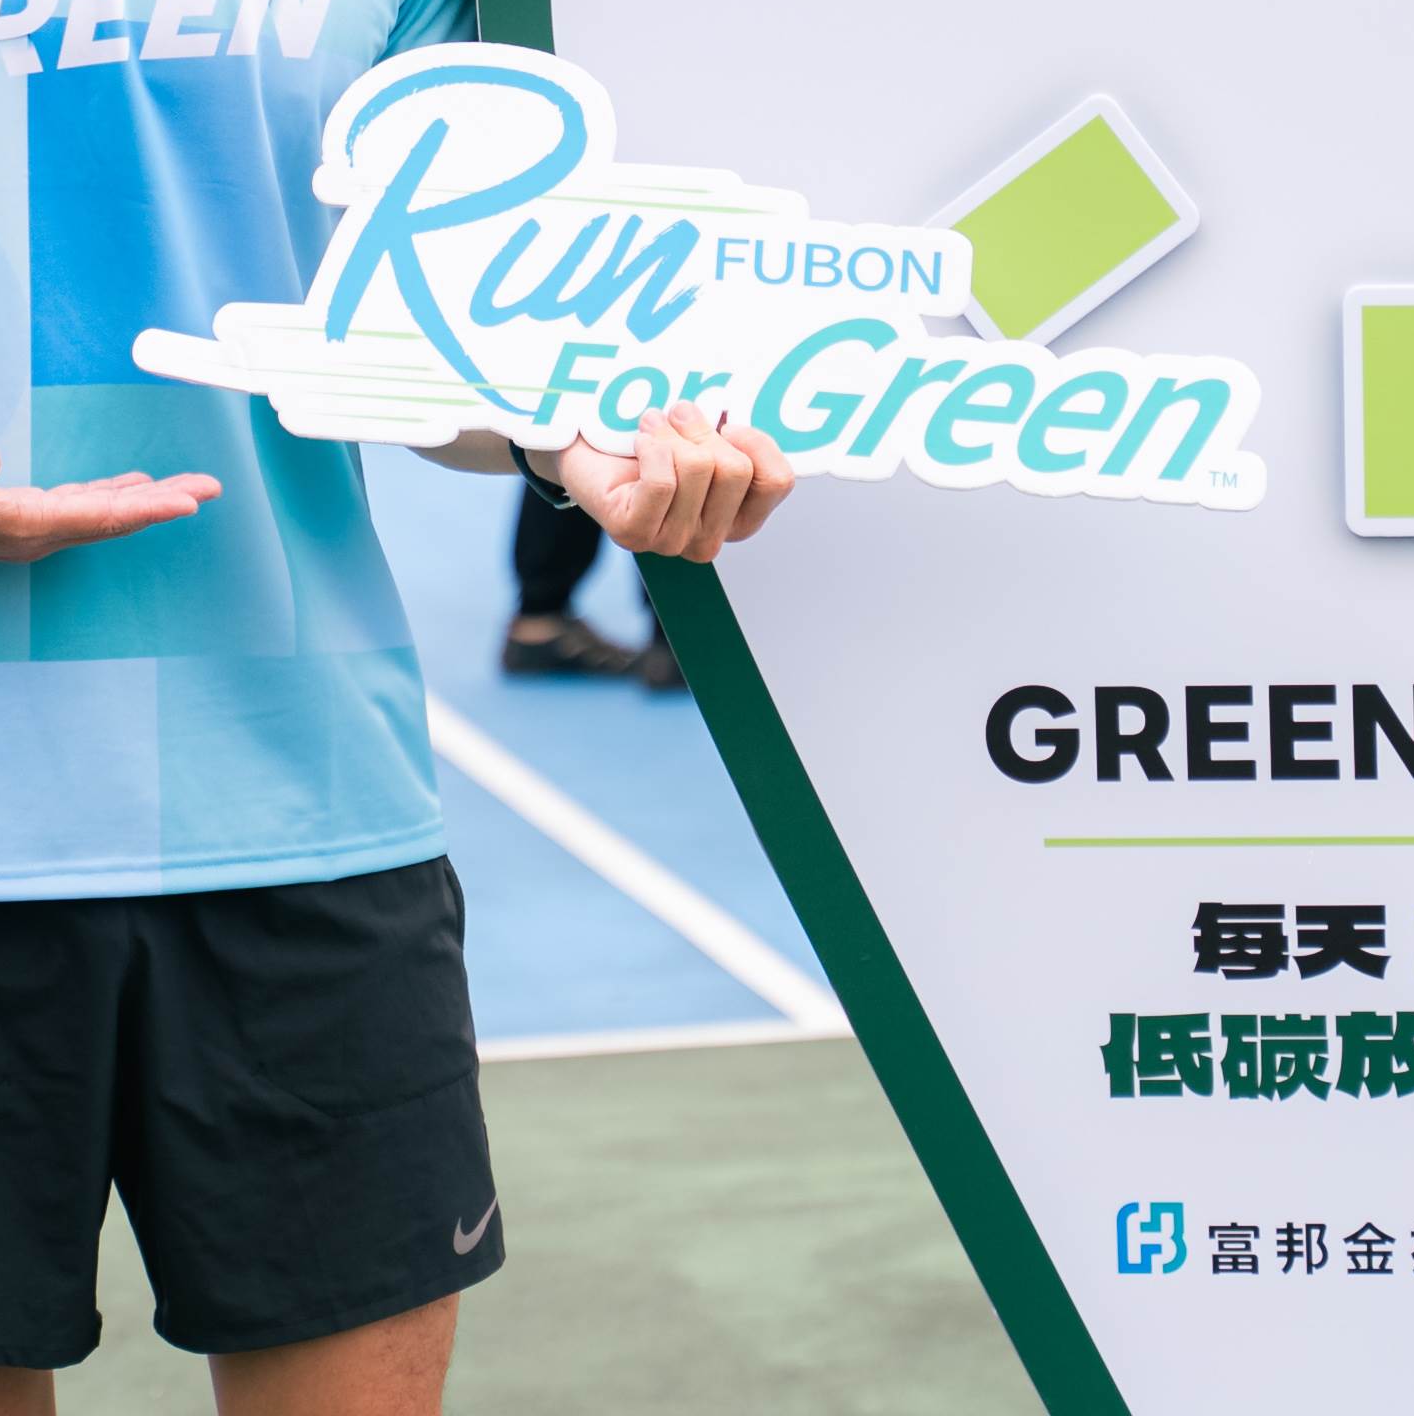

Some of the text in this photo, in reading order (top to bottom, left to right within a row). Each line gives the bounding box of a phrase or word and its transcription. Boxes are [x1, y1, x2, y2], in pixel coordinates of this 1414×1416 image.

[325, 65, 944, 417] Run FUBON
[750, 318, 1232, 482] Green
